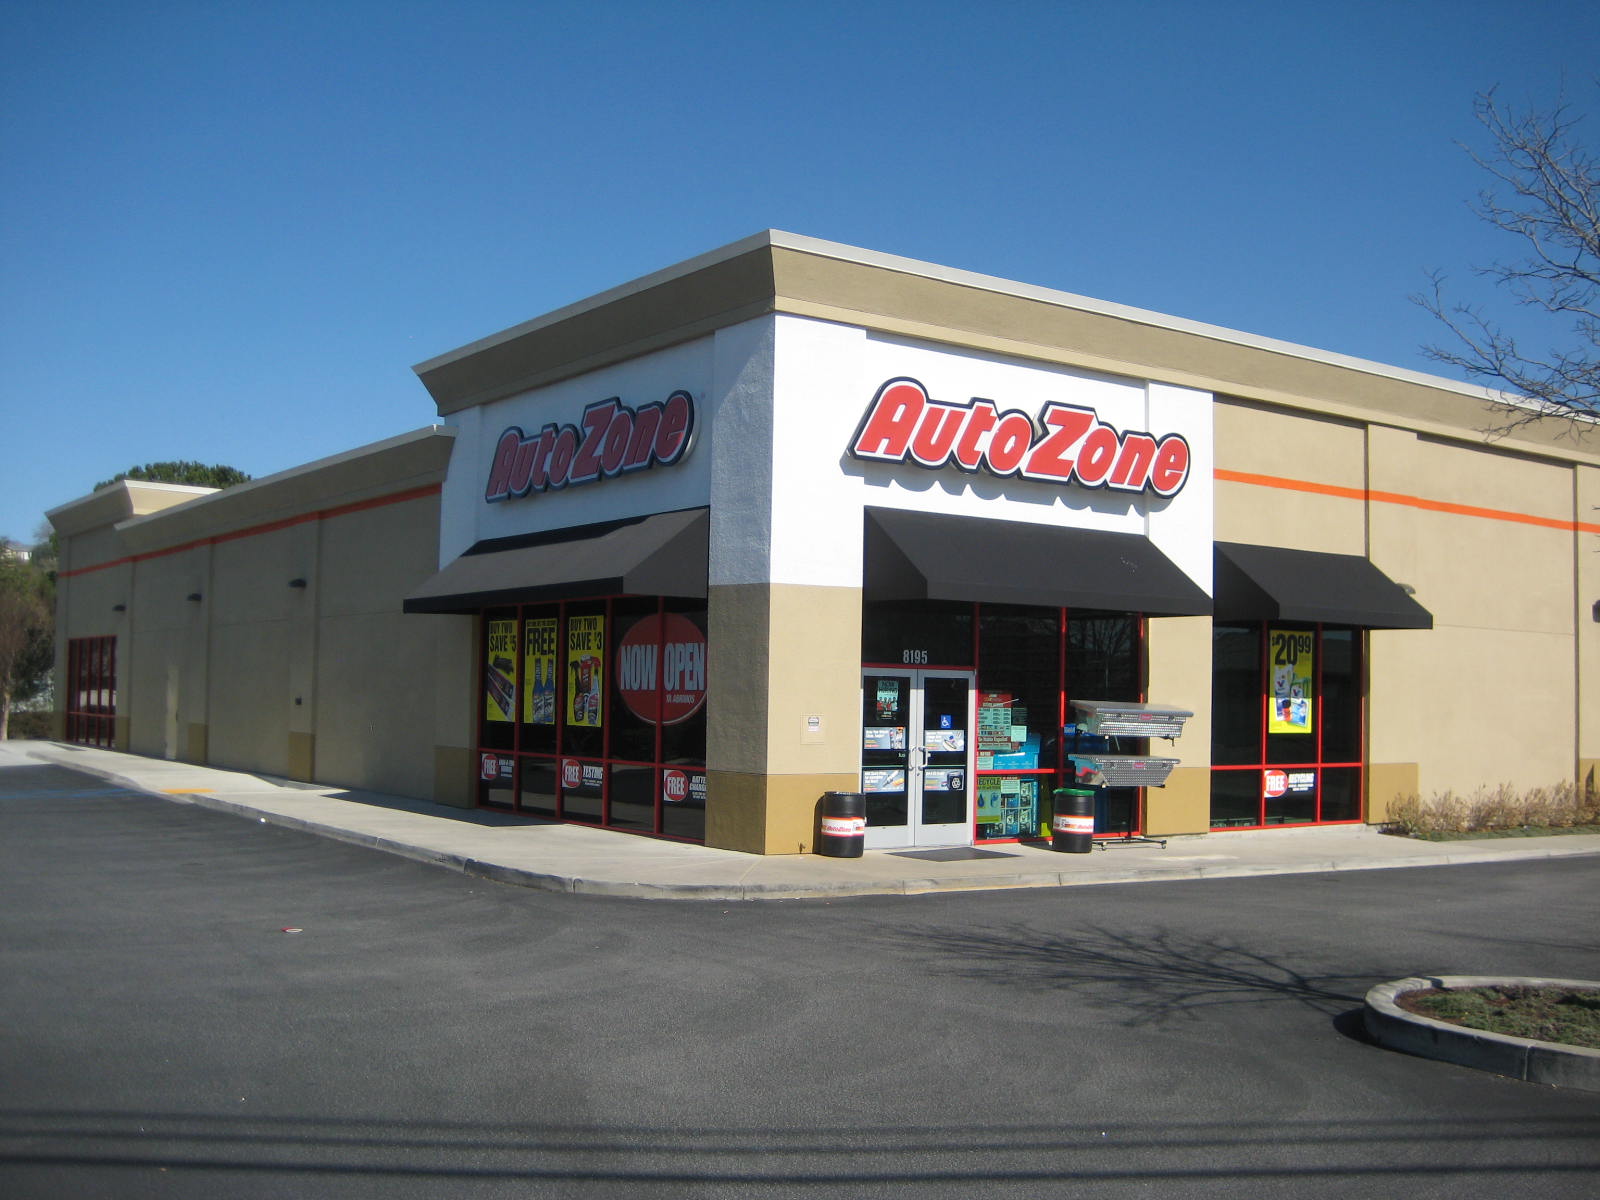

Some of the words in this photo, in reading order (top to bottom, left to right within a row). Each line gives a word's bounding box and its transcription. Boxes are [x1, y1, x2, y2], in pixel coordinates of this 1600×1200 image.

[854, 380, 1189, 496] AutoZone
[486, 394, 695, 502] AutoZone
[490, 623, 500, 634] BUY
[501, 622, 513, 633] TWO
[570, 618, 582, 631] BUY
[584, 617, 597, 631] TWO
[489, 635, 509, 652] SAVE
[527, 627, 555, 656] FREE
[569, 631, 592, 650] SAVE
[902, 649, 928, 664] 8195
[620, 644, 658, 691] NOW
[663, 642, 705, 691] OPEN
[485, 759, 497, 774] FREE
[564, 765, 579, 782] FREE
[666, 776, 685, 795] FREE
[1266, 774, 1285, 792] FREE
